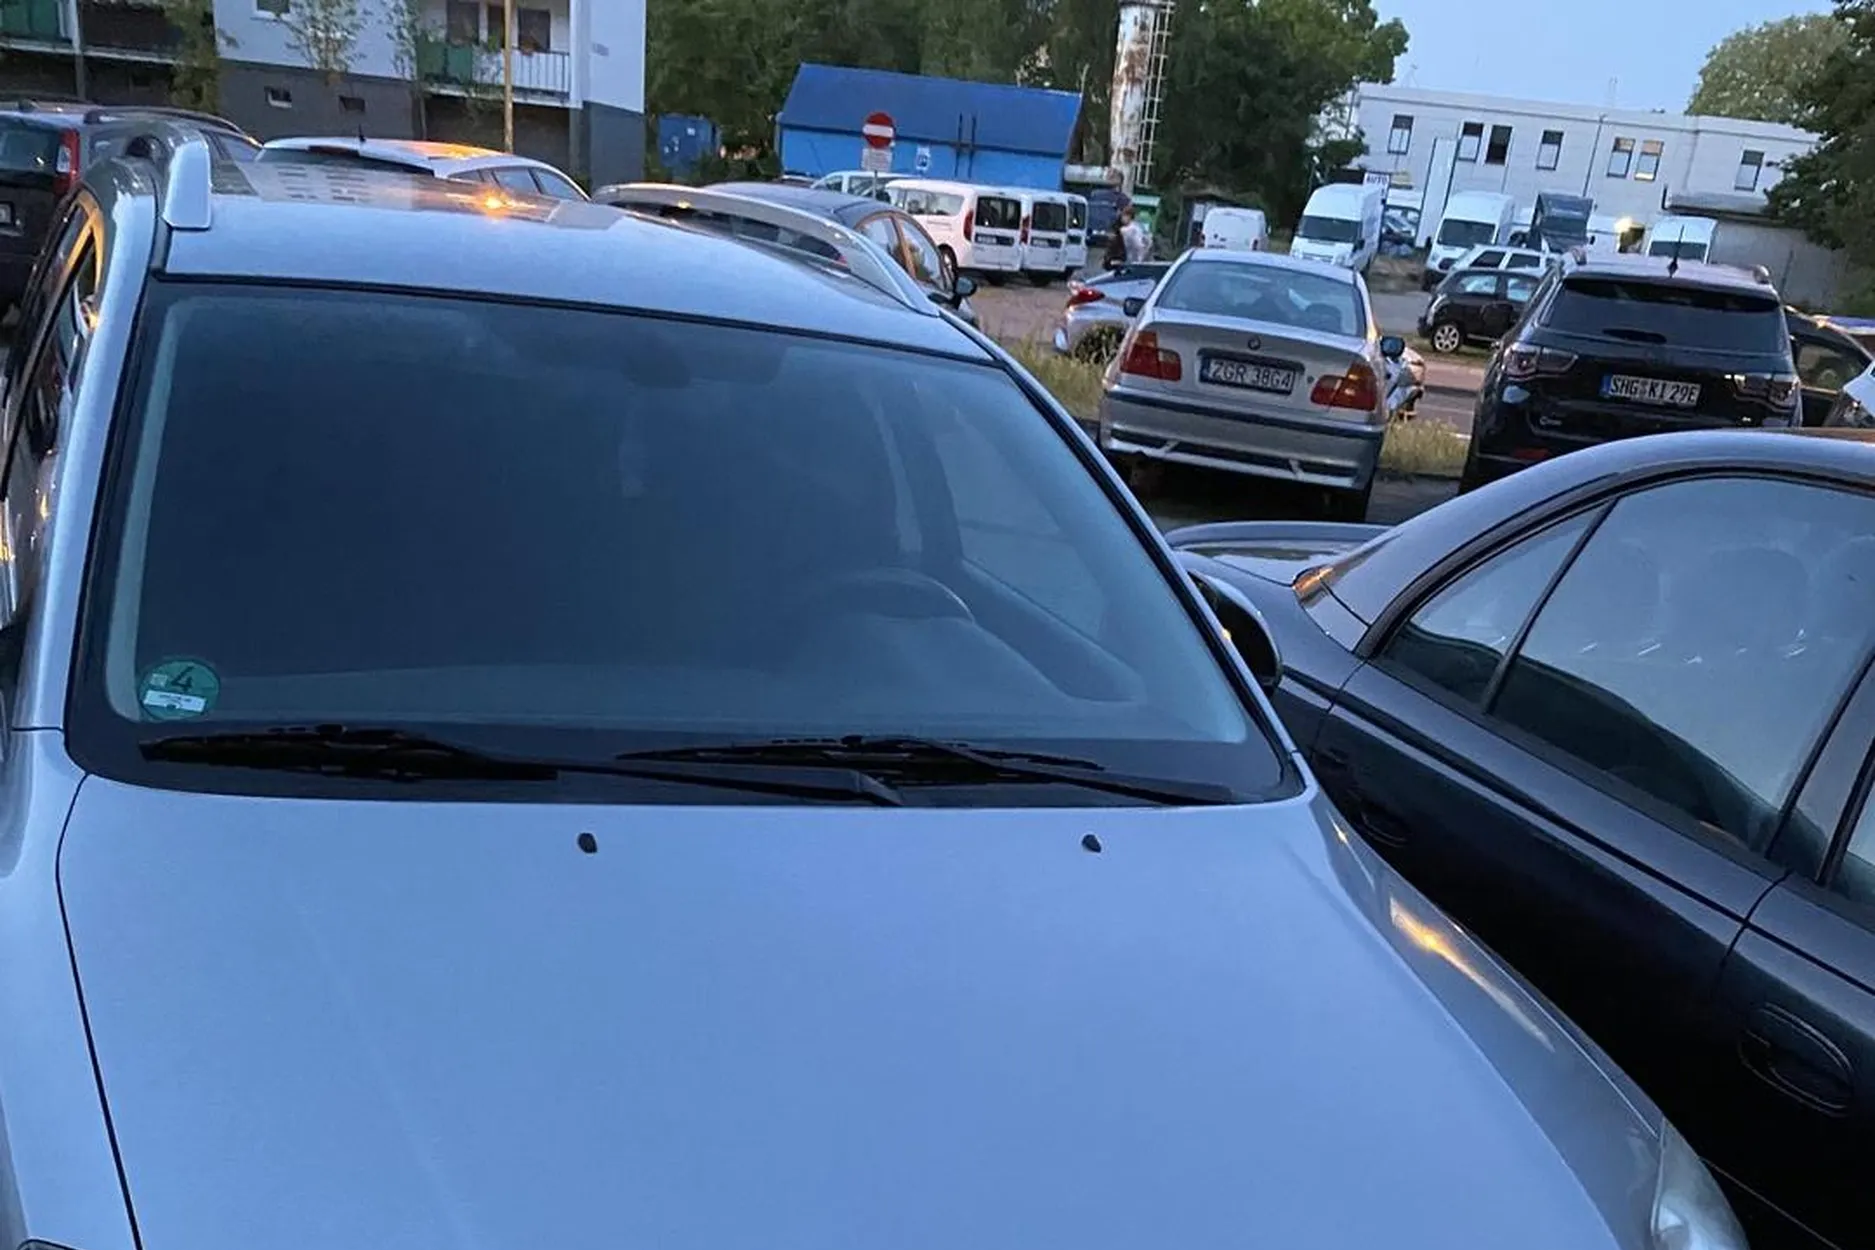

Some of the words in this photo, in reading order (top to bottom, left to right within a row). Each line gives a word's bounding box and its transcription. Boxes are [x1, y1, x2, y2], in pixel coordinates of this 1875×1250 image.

[1211, 360, 1247, 383] ZGR
[1610, 377, 1639, 396] SHG
[170, 665, 195, 692] 4
